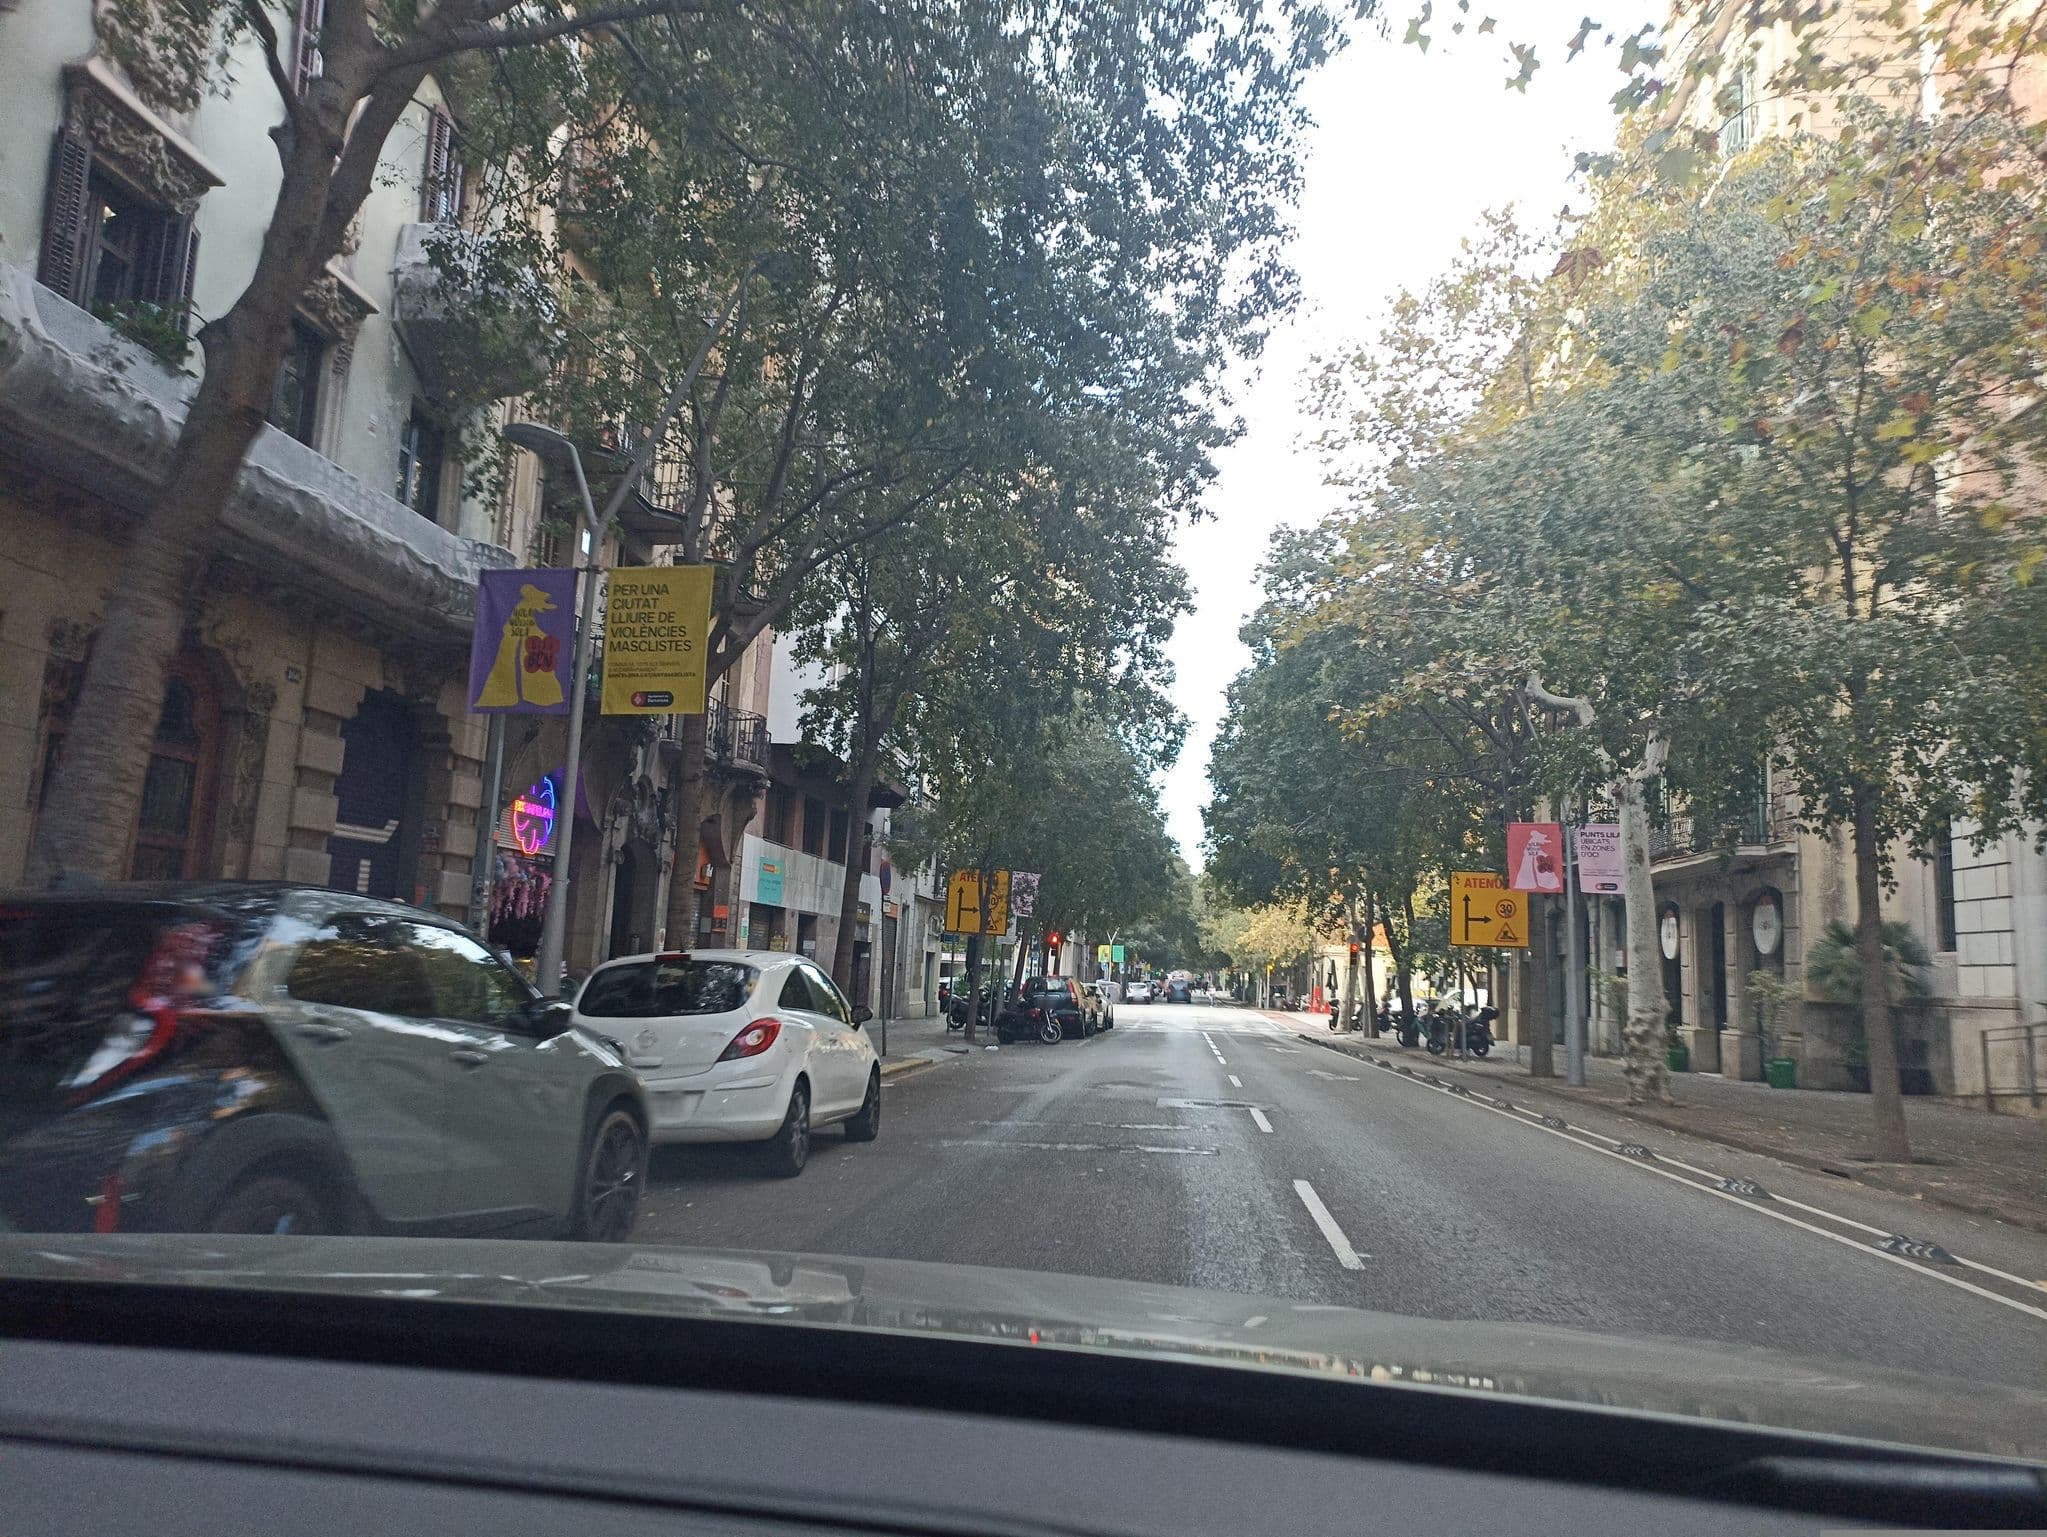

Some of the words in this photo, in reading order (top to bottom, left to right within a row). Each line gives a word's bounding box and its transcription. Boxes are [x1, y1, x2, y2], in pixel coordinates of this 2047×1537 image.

[613, 584, 638, 595] PER
[641, 584, 669, 595] UNA
[612, 598, 659, 609] CIUTAT
[611, 612, 655, 623] LLIURE
[658, 611, 676, 623] DE
[610, 624, 687, 638] VIOLÈNCIES
[609, 639, 692, 652] MASCLISTES
[1464, 878, 1502, 889] ATENC
[1500, 904, 1512, 914] 30
